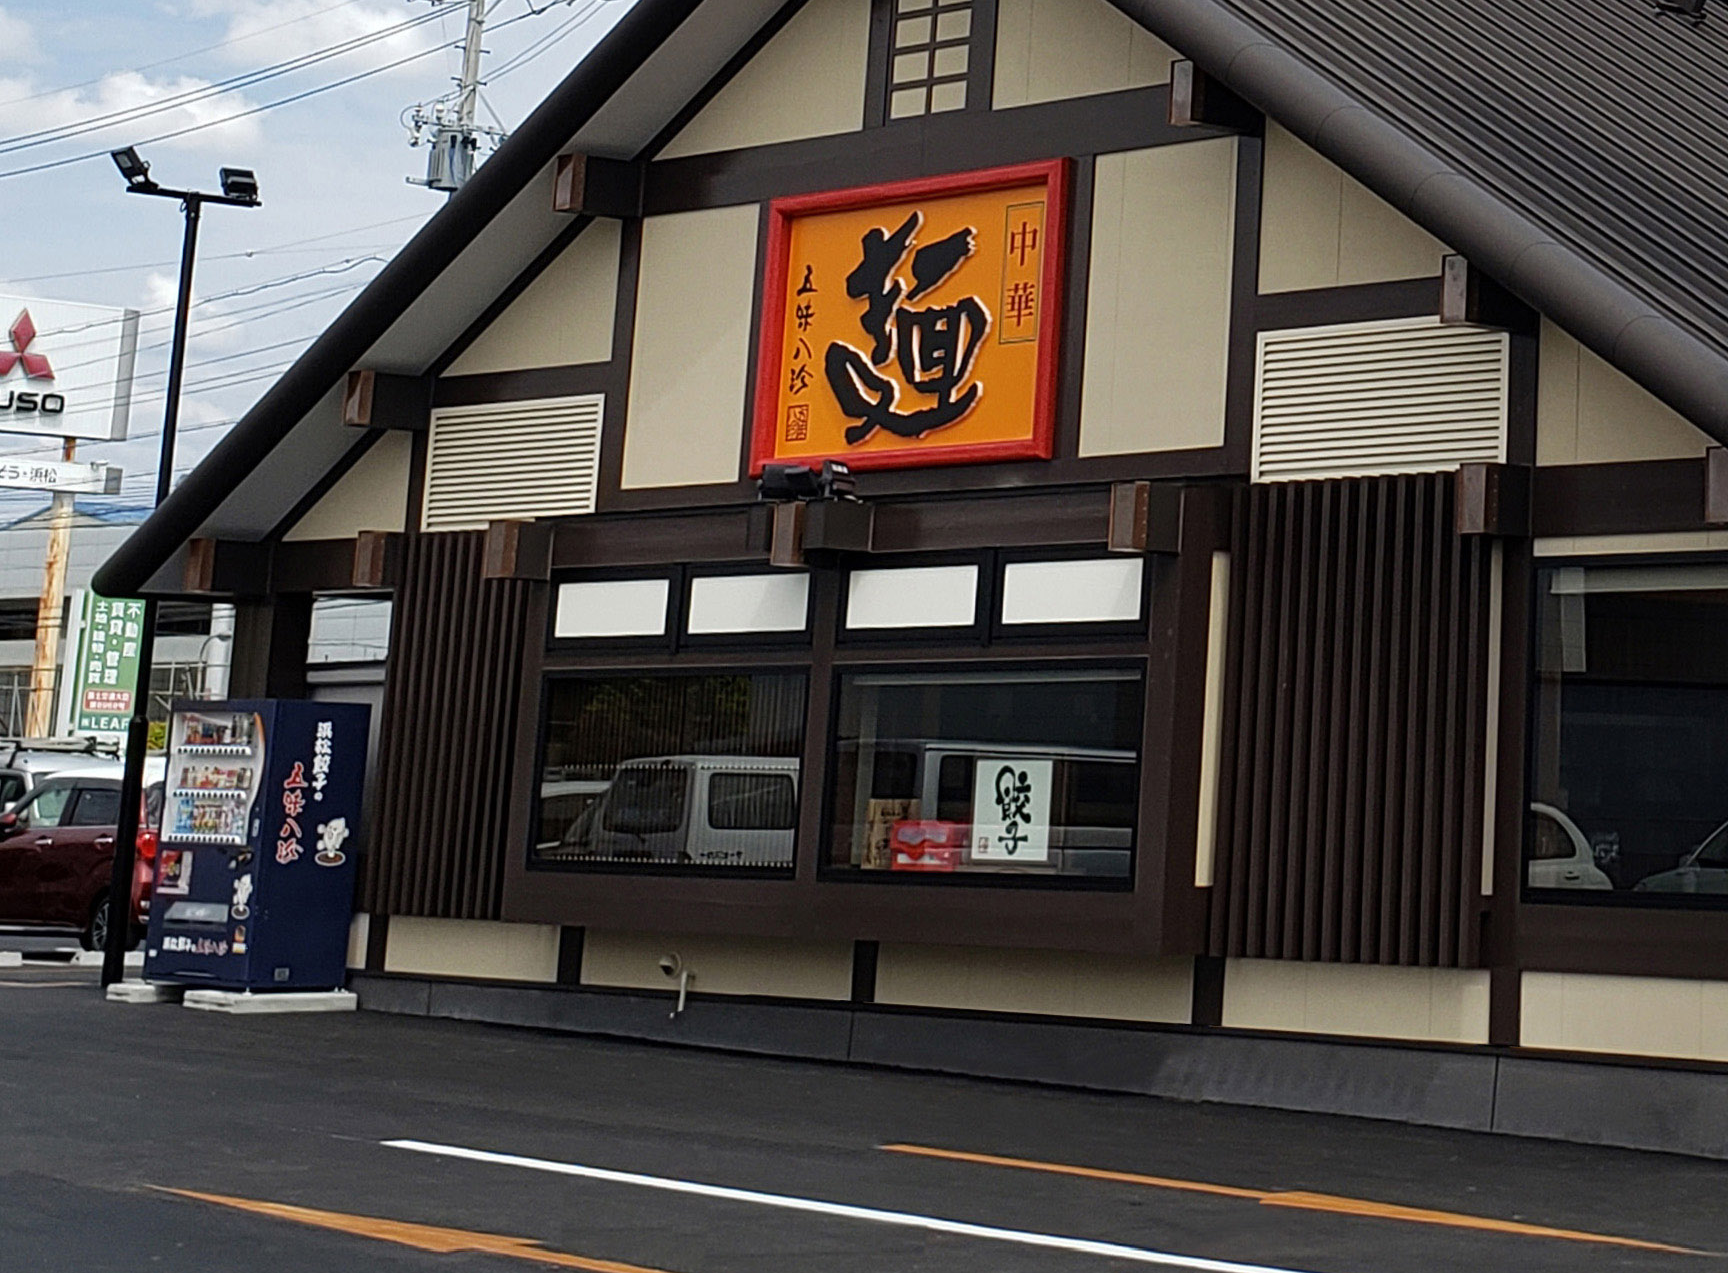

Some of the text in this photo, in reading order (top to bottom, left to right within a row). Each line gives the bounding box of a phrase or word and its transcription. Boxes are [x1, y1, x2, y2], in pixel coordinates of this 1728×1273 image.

[1004, 220, 1039, 328] 中華
[788, 264, 818, 395] 五味八珍
[995, 765, 1032, 856] 餃子
